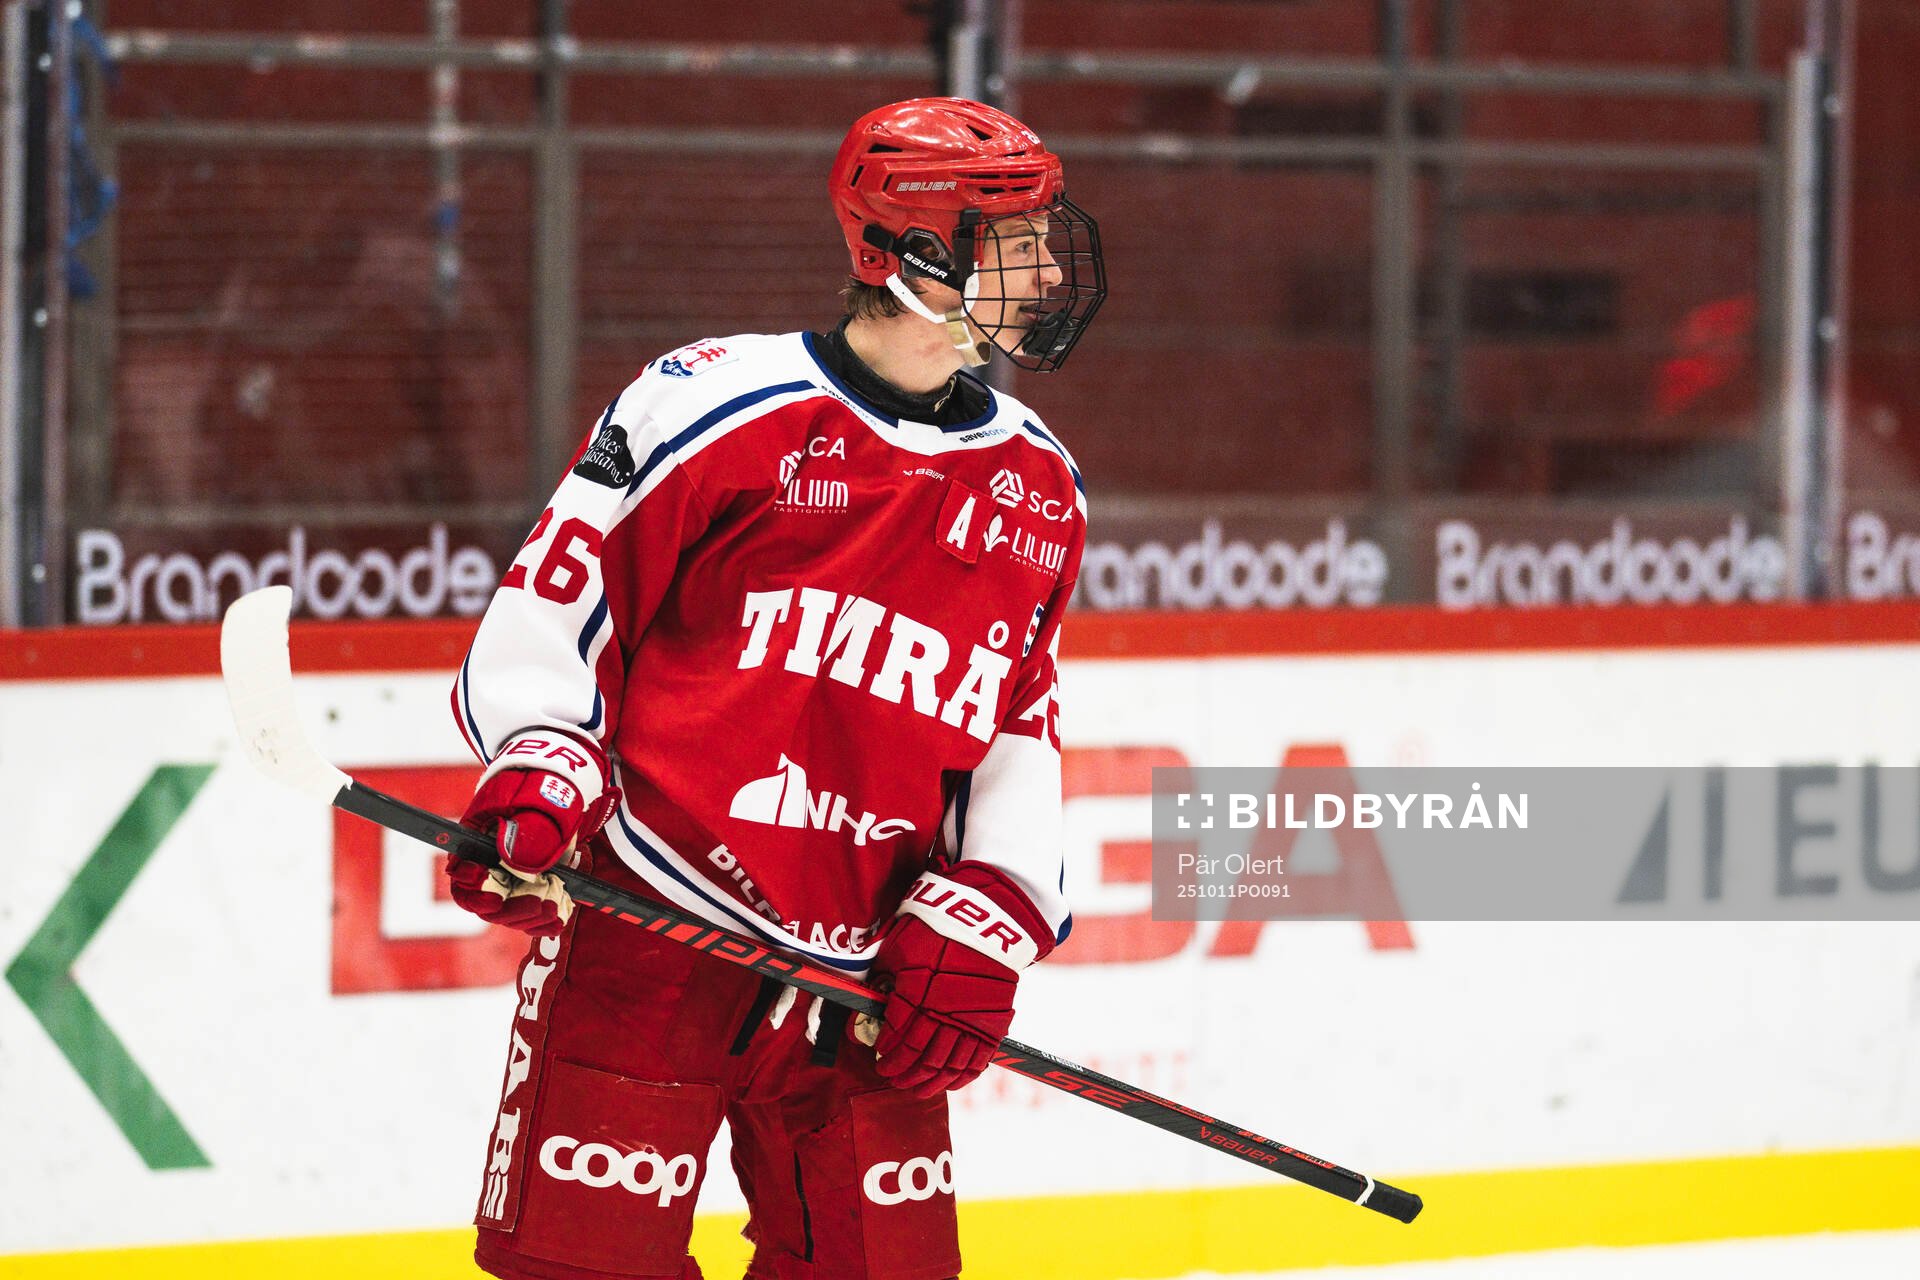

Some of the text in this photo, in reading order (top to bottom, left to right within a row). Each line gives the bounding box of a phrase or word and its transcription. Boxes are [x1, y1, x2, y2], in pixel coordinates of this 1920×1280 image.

[896, 181, 958, 192] BAUER
[903, 252, 949, 279] BAUER
[801, 436, 846, 460] CA
[946, 496, 977, 550] A
[1028, 491, 1074, 523] SCA
[904, 879, 1023, 954] UER
[1209, 1134, 1279, 1164] BAUER
[539, 1135, 698, 1208] coop
[862, 1150, 954, 1206] coo
